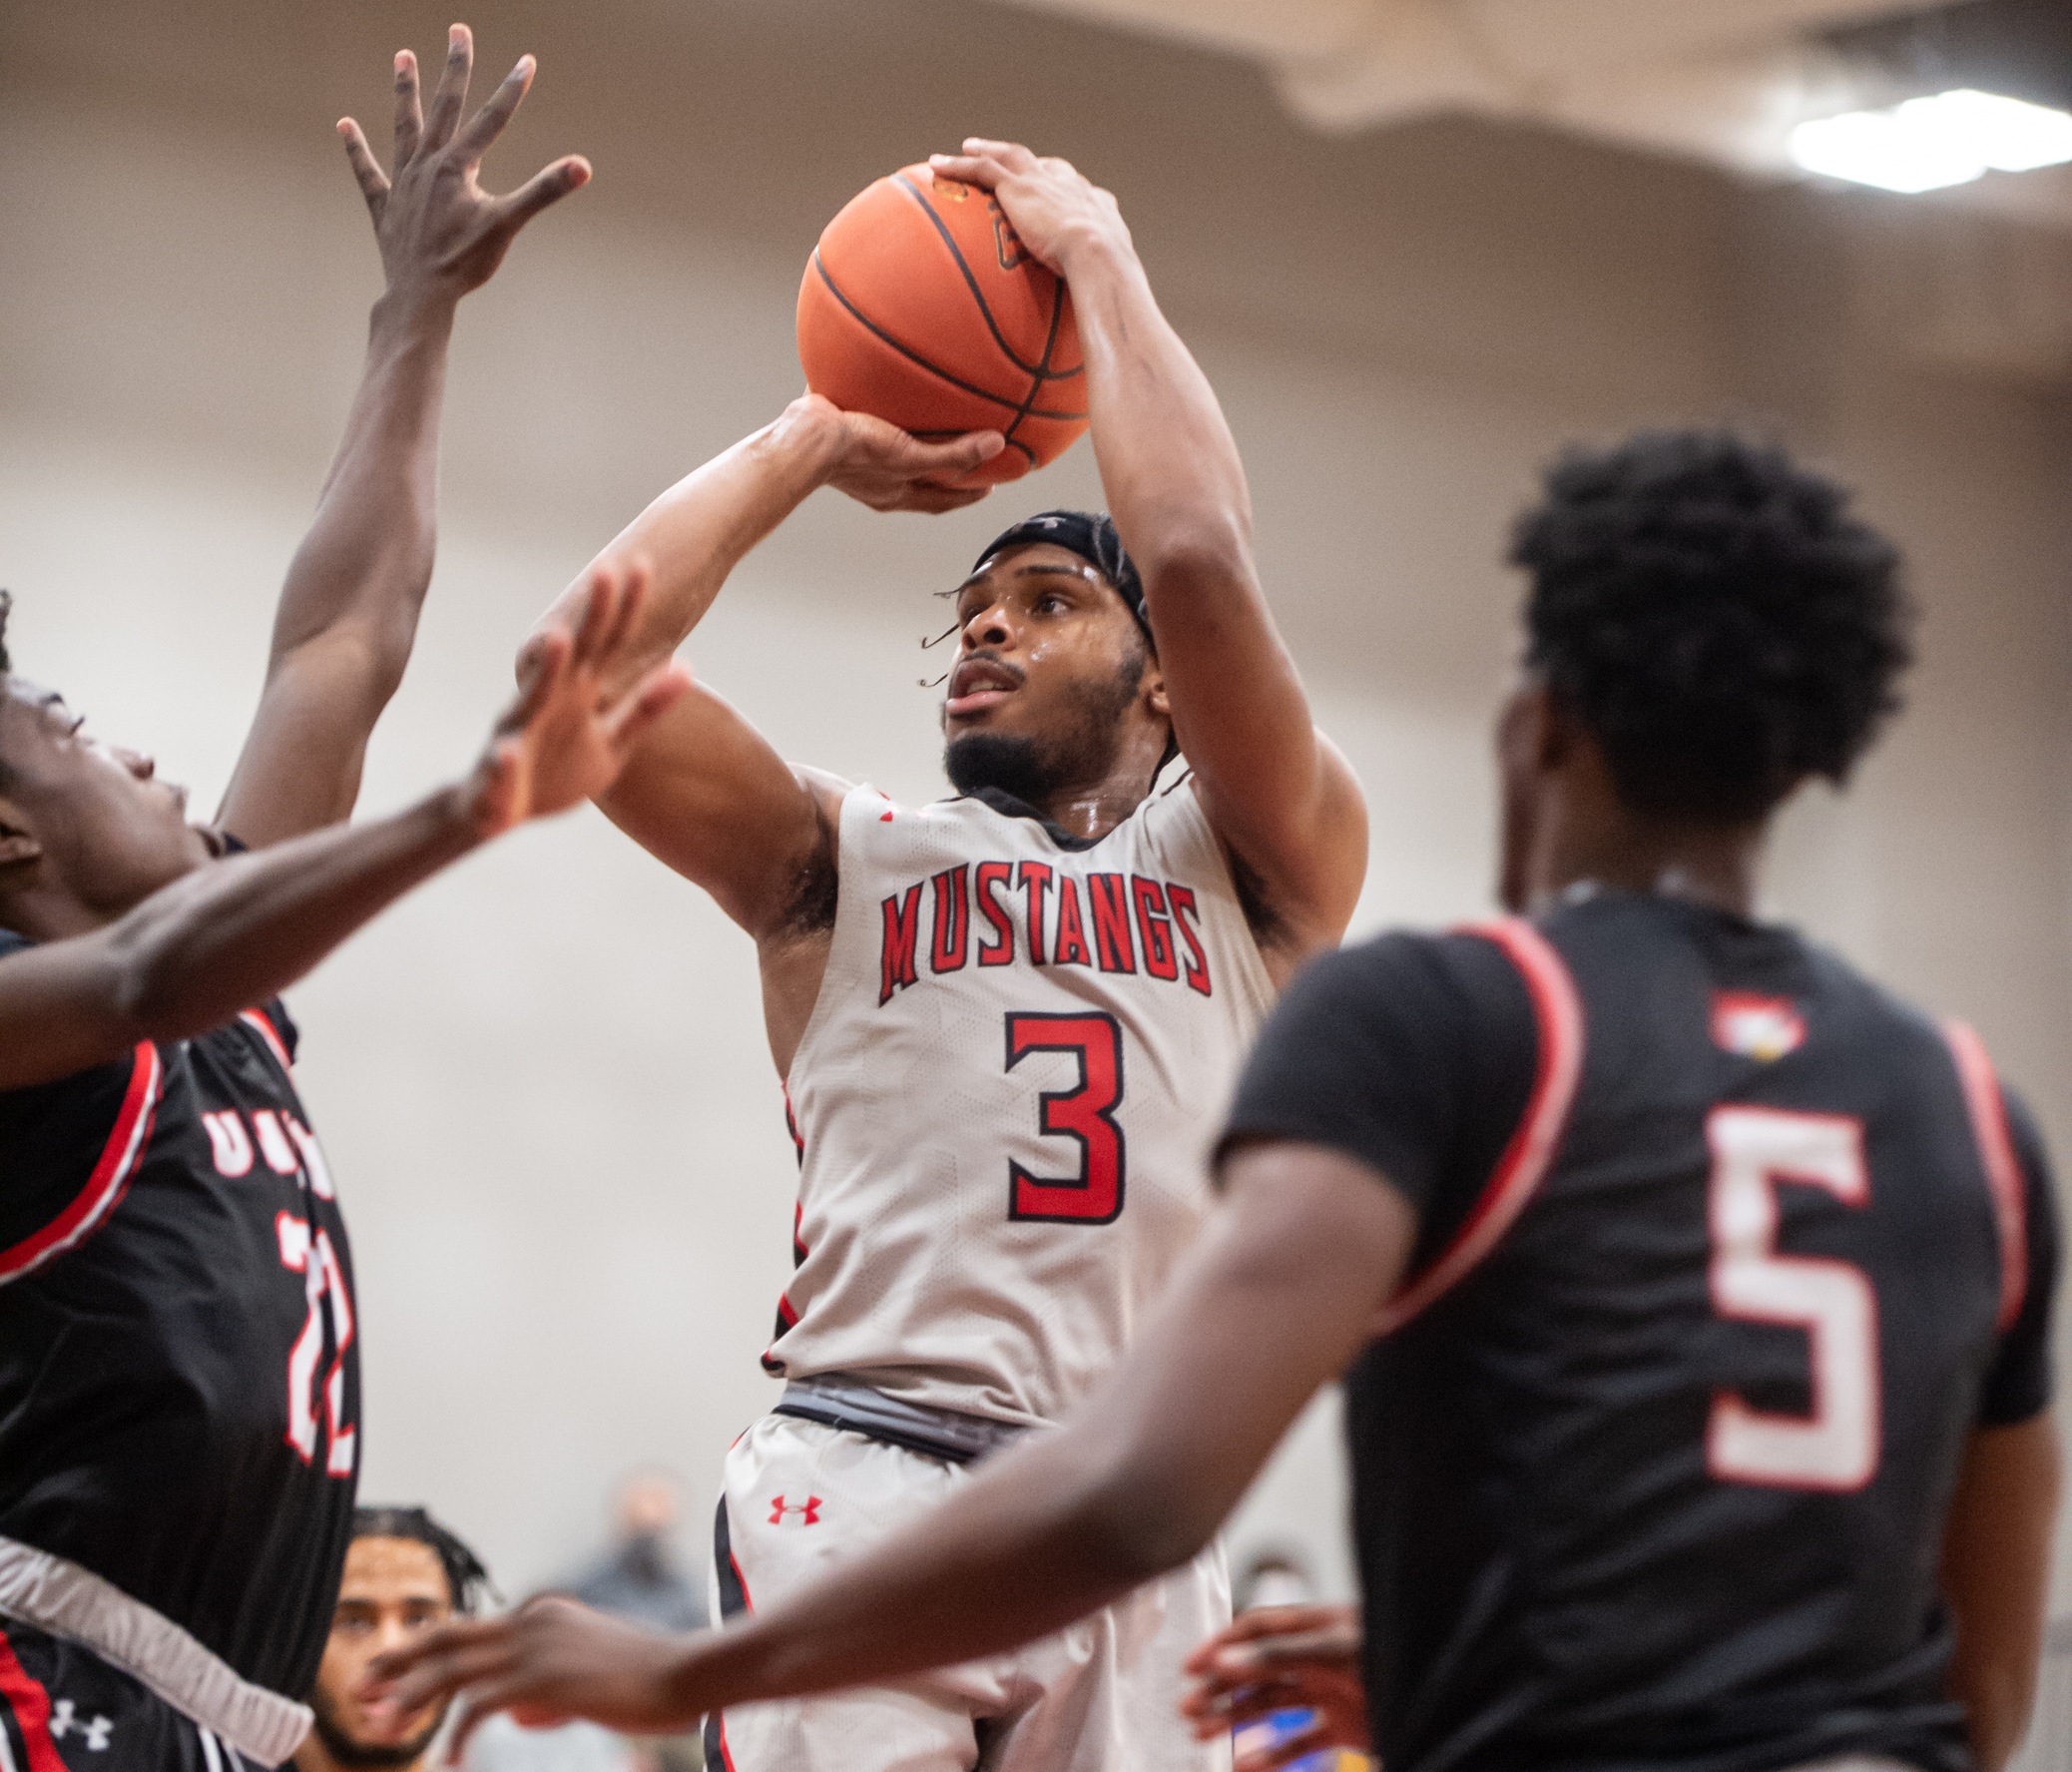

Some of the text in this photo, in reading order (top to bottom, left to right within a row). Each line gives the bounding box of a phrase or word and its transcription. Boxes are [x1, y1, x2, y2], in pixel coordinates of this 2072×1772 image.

[878, 861, 1212, 1008] MUSTANGS
[1004, 1011, 1125, 1226] 3
[1705, 1103, 1883, 1493] 5
